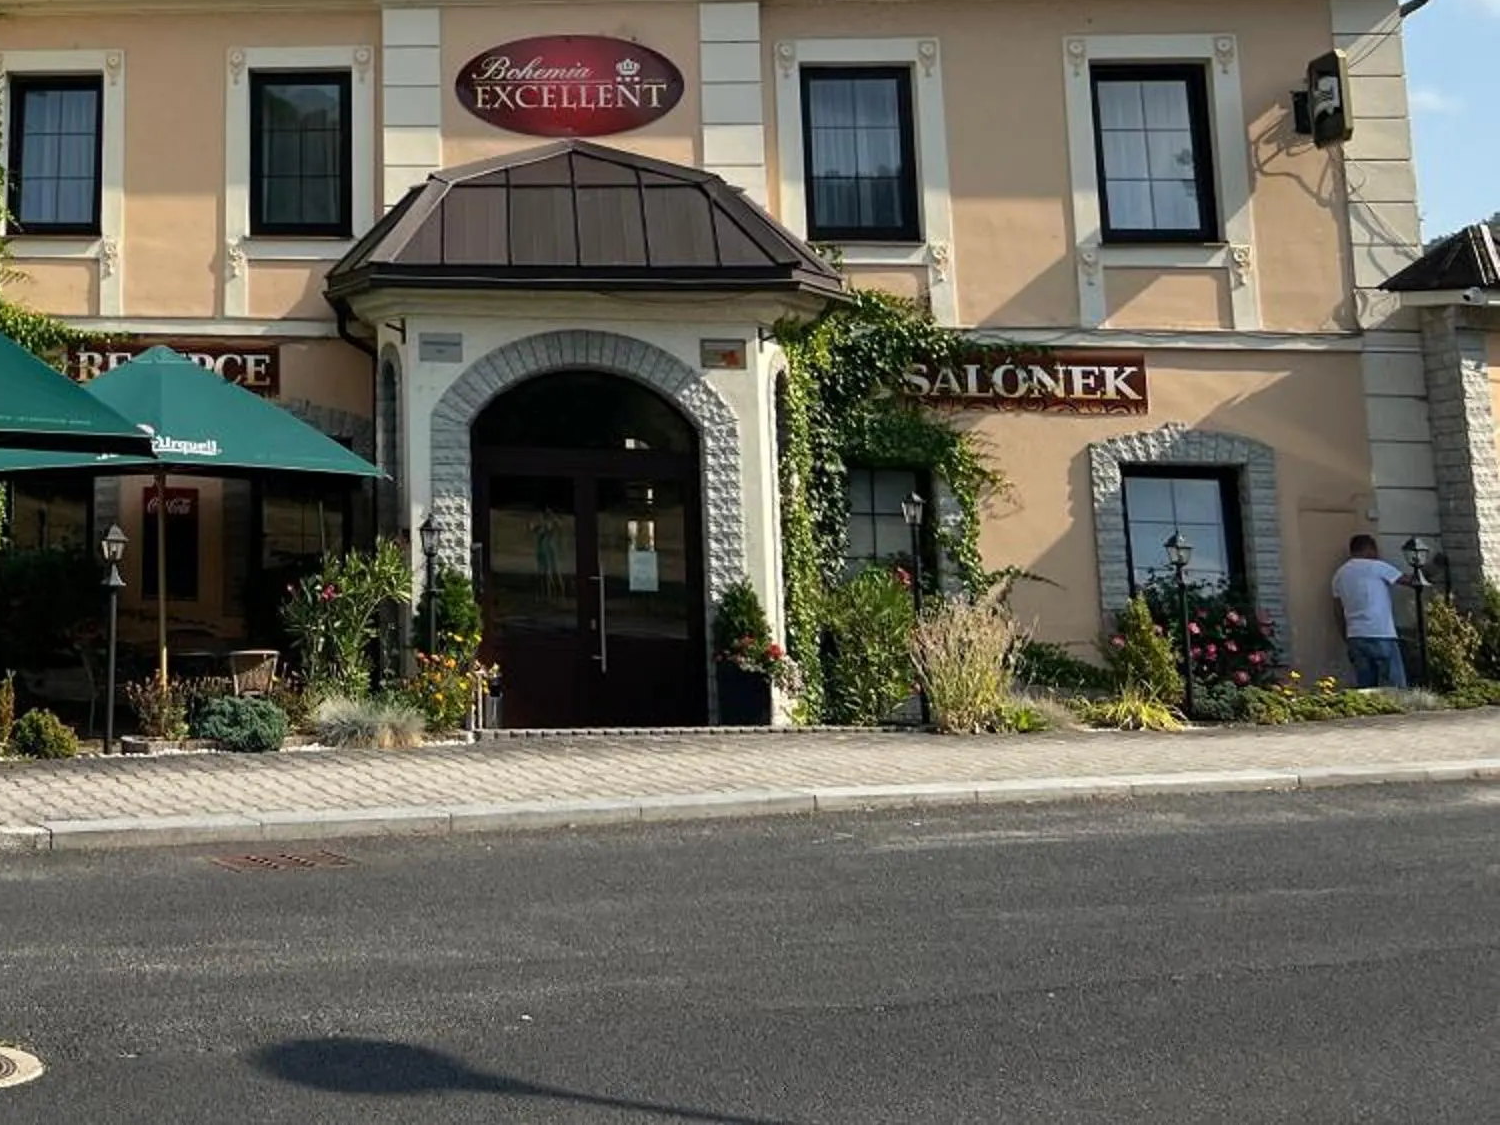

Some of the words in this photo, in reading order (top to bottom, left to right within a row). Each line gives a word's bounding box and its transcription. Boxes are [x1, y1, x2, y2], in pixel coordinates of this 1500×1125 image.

[472, 56, 596, 80] Bohemia
[475, 82, 667, 112] EXCELLENT
[901, 355, 1143, 400] SALÓNEK
